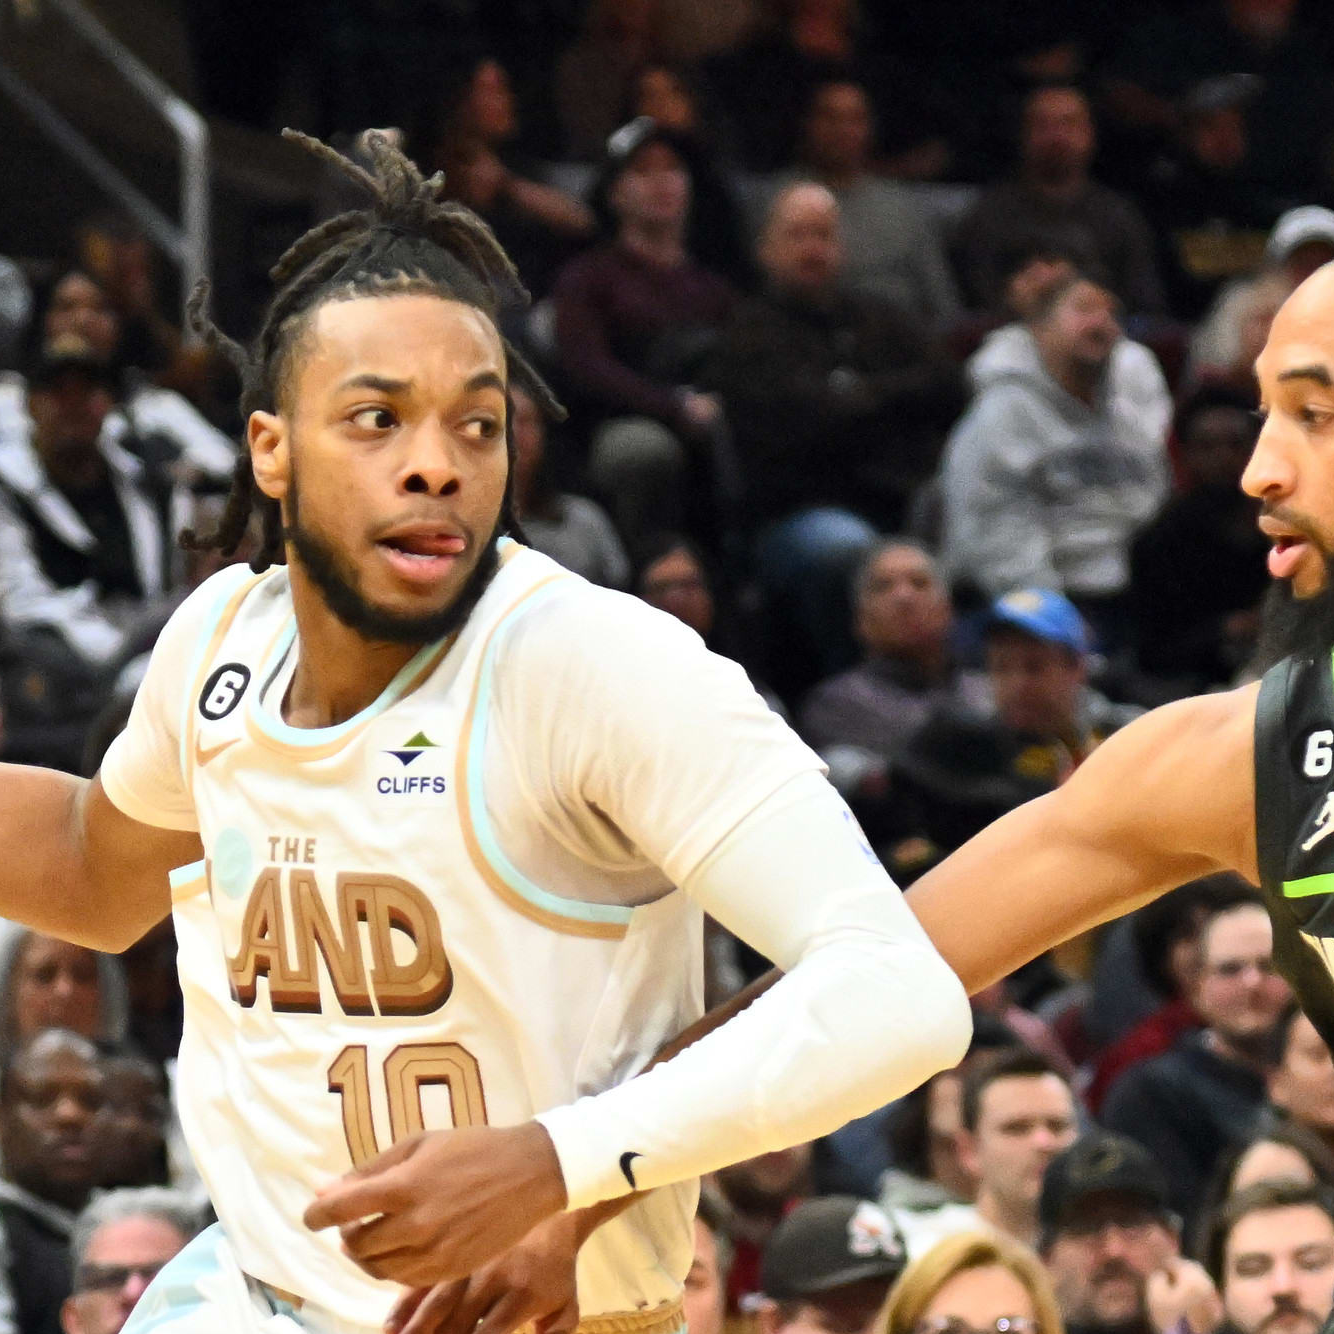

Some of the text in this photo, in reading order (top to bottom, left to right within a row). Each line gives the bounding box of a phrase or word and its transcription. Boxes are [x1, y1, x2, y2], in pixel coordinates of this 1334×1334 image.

[203, 668, 248, 715] 6
[1303, 729, 1334, 778] 6
[377, 775, 446, 794] CLIFFS
[267, 836, 317, 864] THE
[206, 860, 454, 1017] AND
[327, 1041, 489, 1172] 10
